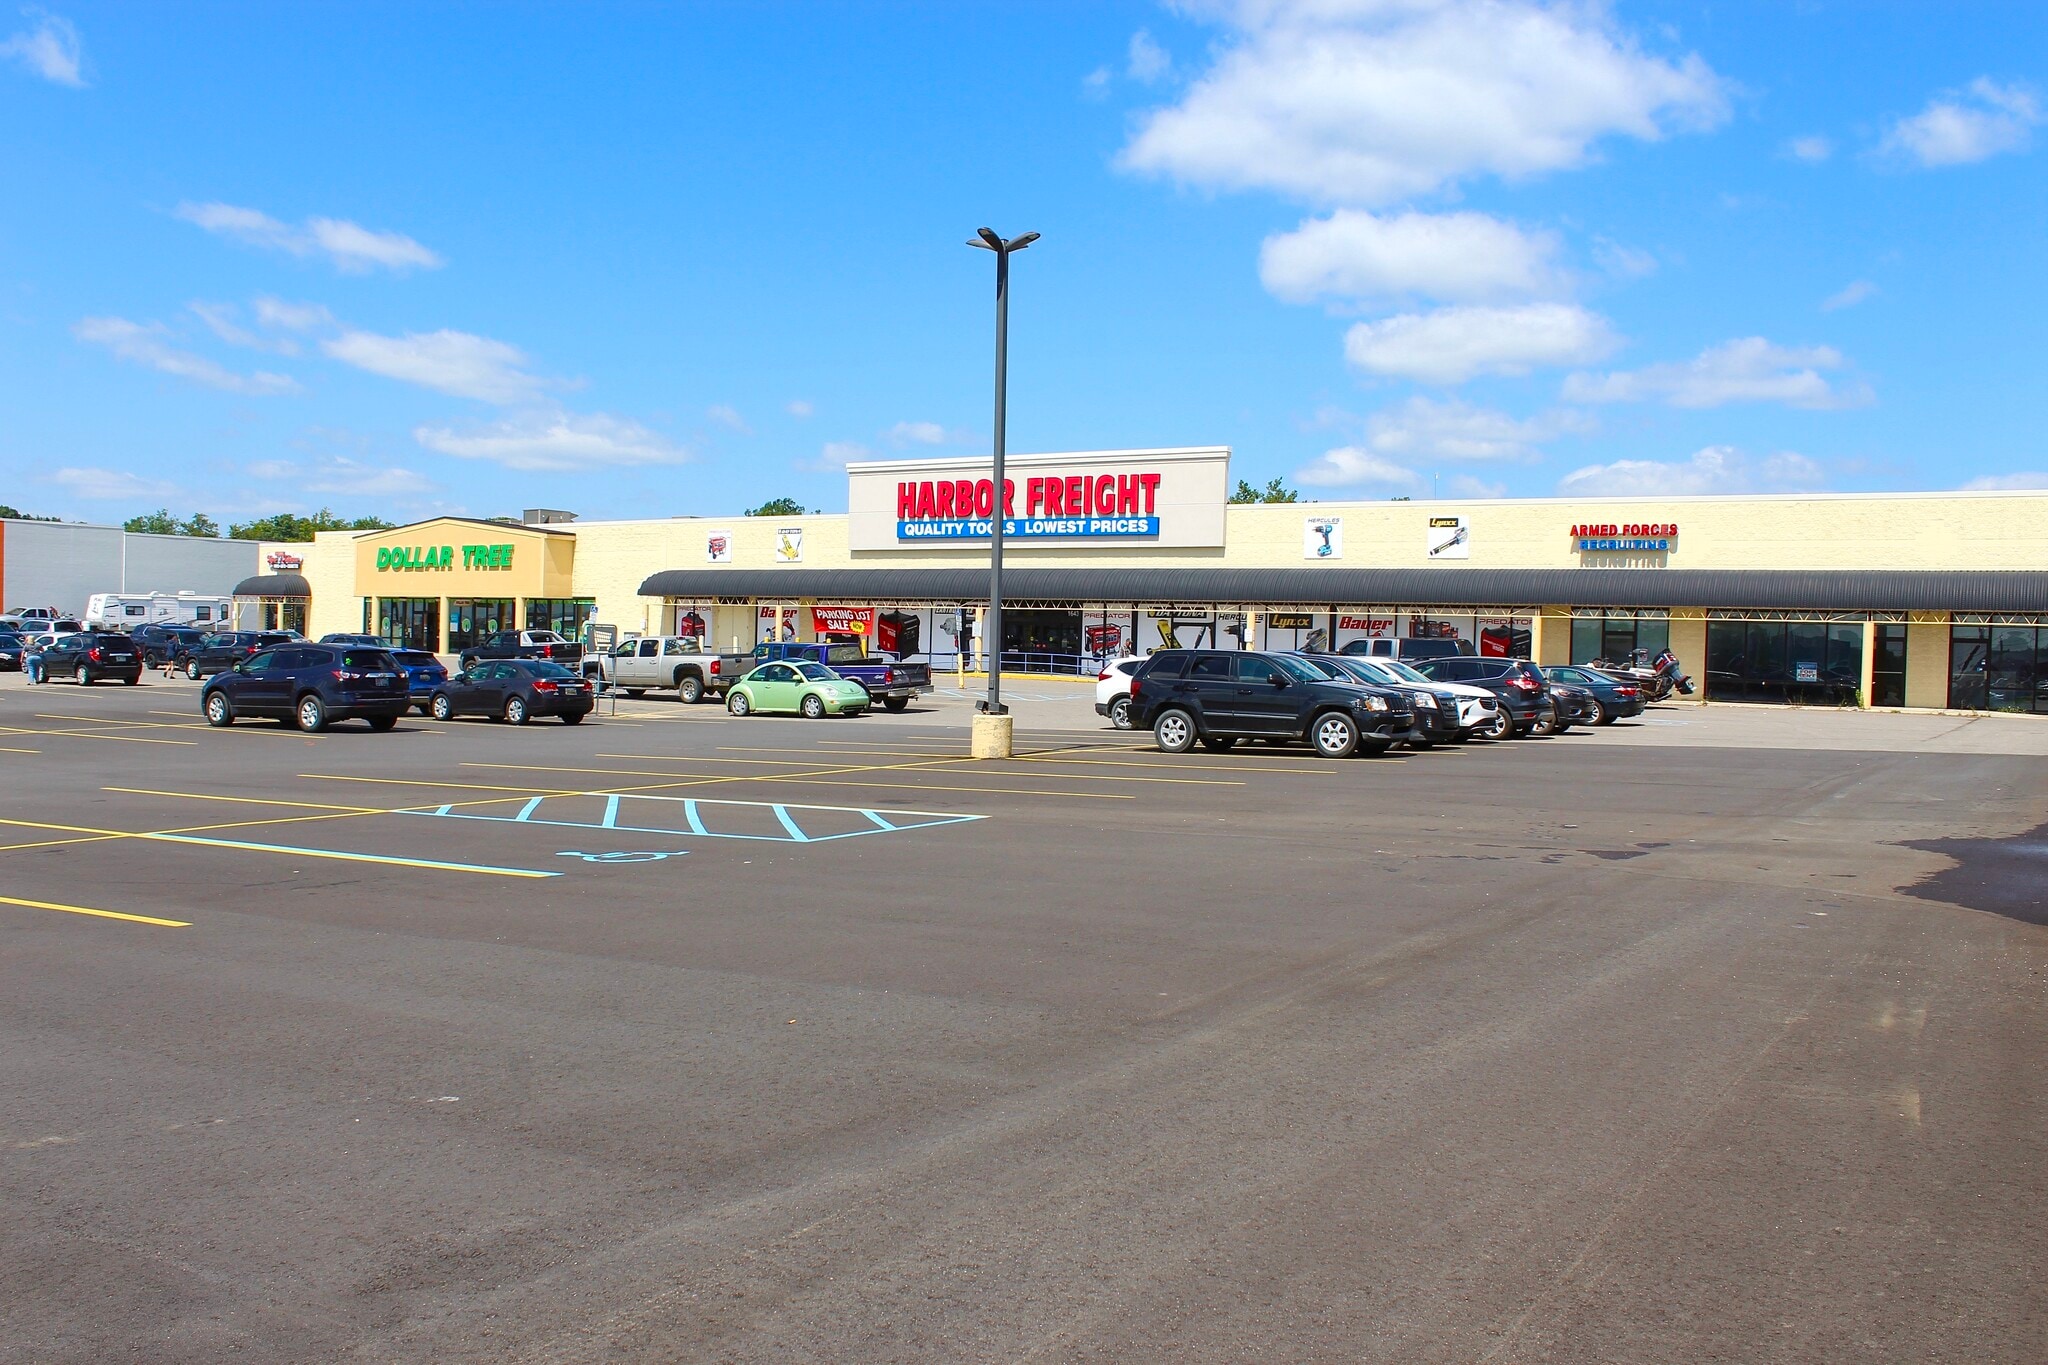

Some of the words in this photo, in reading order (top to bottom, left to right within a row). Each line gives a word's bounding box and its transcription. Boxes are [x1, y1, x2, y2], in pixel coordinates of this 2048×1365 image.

[897, 479, 1014, 518] HARBOR
[1025, 473, 1161, 516] FREIGHT
[904, 522, 964, 536] QUALITY
[968, 522, 1016, 535] TOOS
[1025, 521, 1086, 534] LOWEST
[1090, 519, 1149, 533] PRICES
[1569, 524, 1618, 536] ARMED
[1622, 523, 1678, 536] FORCES
[1579, 539, 1669, 550] RECRUITING
[376, 546, 454, 569] DOLLAR
[462, 544, 515, 567] TREE
[760, 606, 797, 618] Baer
[816, 609, 854, 620] PARKING
[854, 610, 871, 621] LOT
[1218, 613, 1264, 621] HERCUES
[827, 619, 849, 631] SALE
[1338, 616, 1393, 630] Bauer
